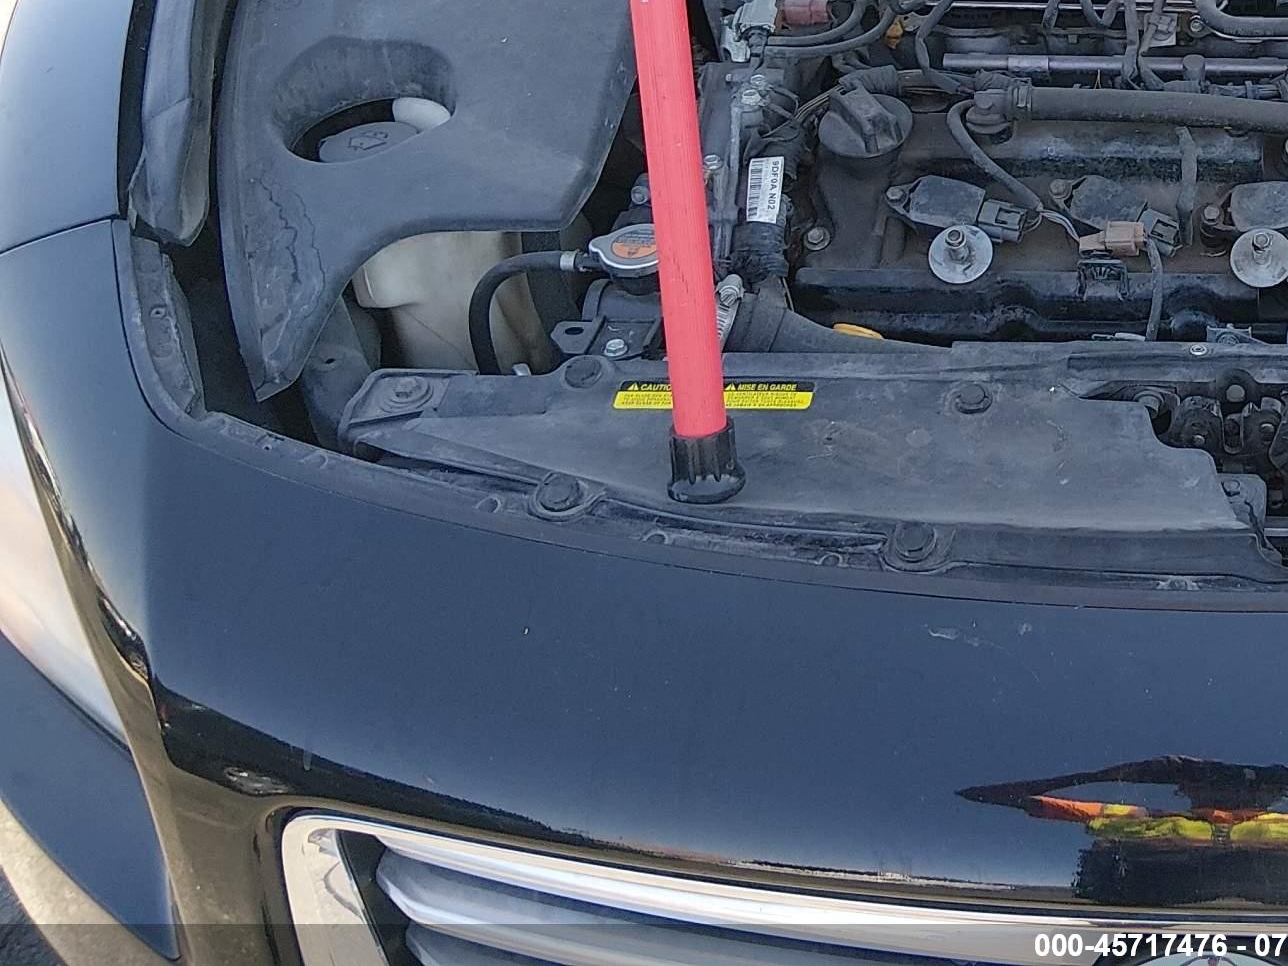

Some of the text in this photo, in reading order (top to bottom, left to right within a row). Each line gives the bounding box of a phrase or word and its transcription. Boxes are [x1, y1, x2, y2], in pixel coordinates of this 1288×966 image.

[640, 383, 673, 392] CAUTIO
[737, 383, 798, 392] MISE EN GARDE
